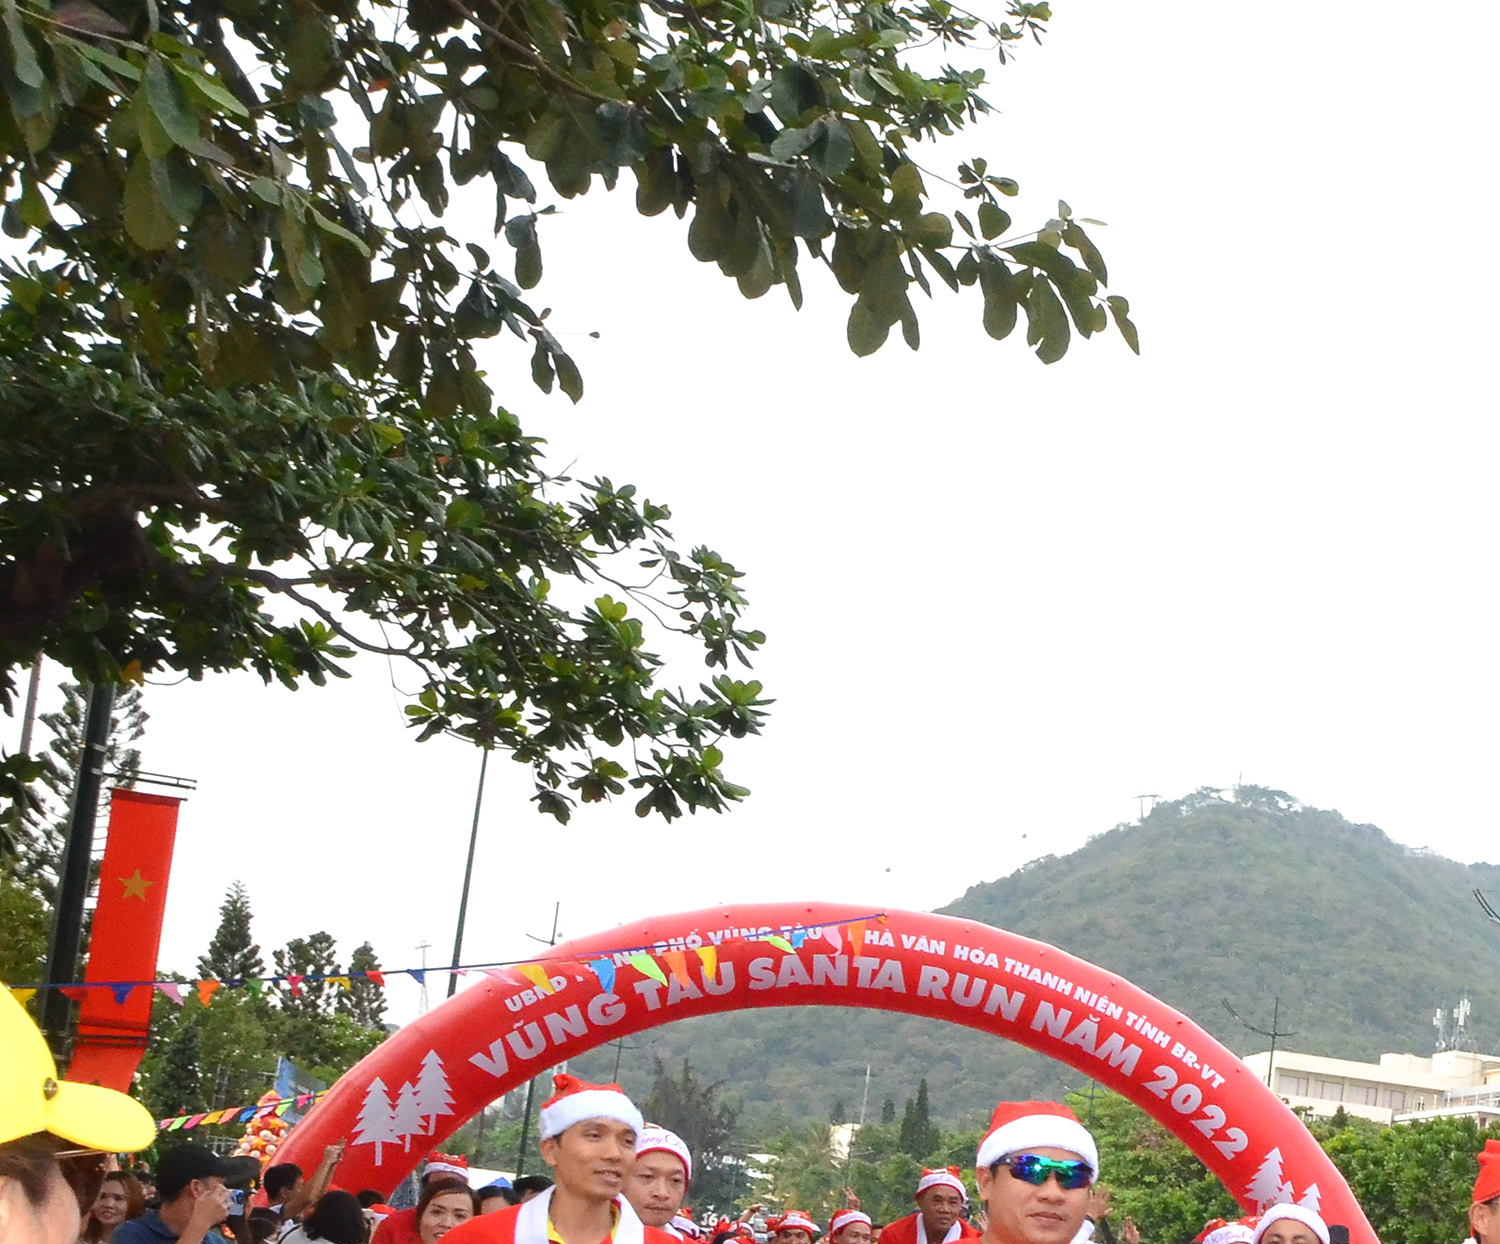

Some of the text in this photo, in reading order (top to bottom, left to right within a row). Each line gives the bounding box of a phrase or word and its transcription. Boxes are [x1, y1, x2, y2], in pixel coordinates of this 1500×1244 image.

[468, 992, 627, 1078] VŨNG
[748, 953, 907, 994] SANTA
[917, 964, 1027, 1022] RUN
[1030, 1000, 1143, 1077] NĂM
[1141, 1065, 1249, 1160] 2022
[901, 935, 946, 956] VĂN
[953, 946, 999, 969] HÓA
[1004, 957, 1073, 996] THANH
[1073, 986, 1124, 1020] NIÊN
[1125, 1015, 1171, 1048] TỈNH
[1171, 1041, 1226, 1089] BR-VT
